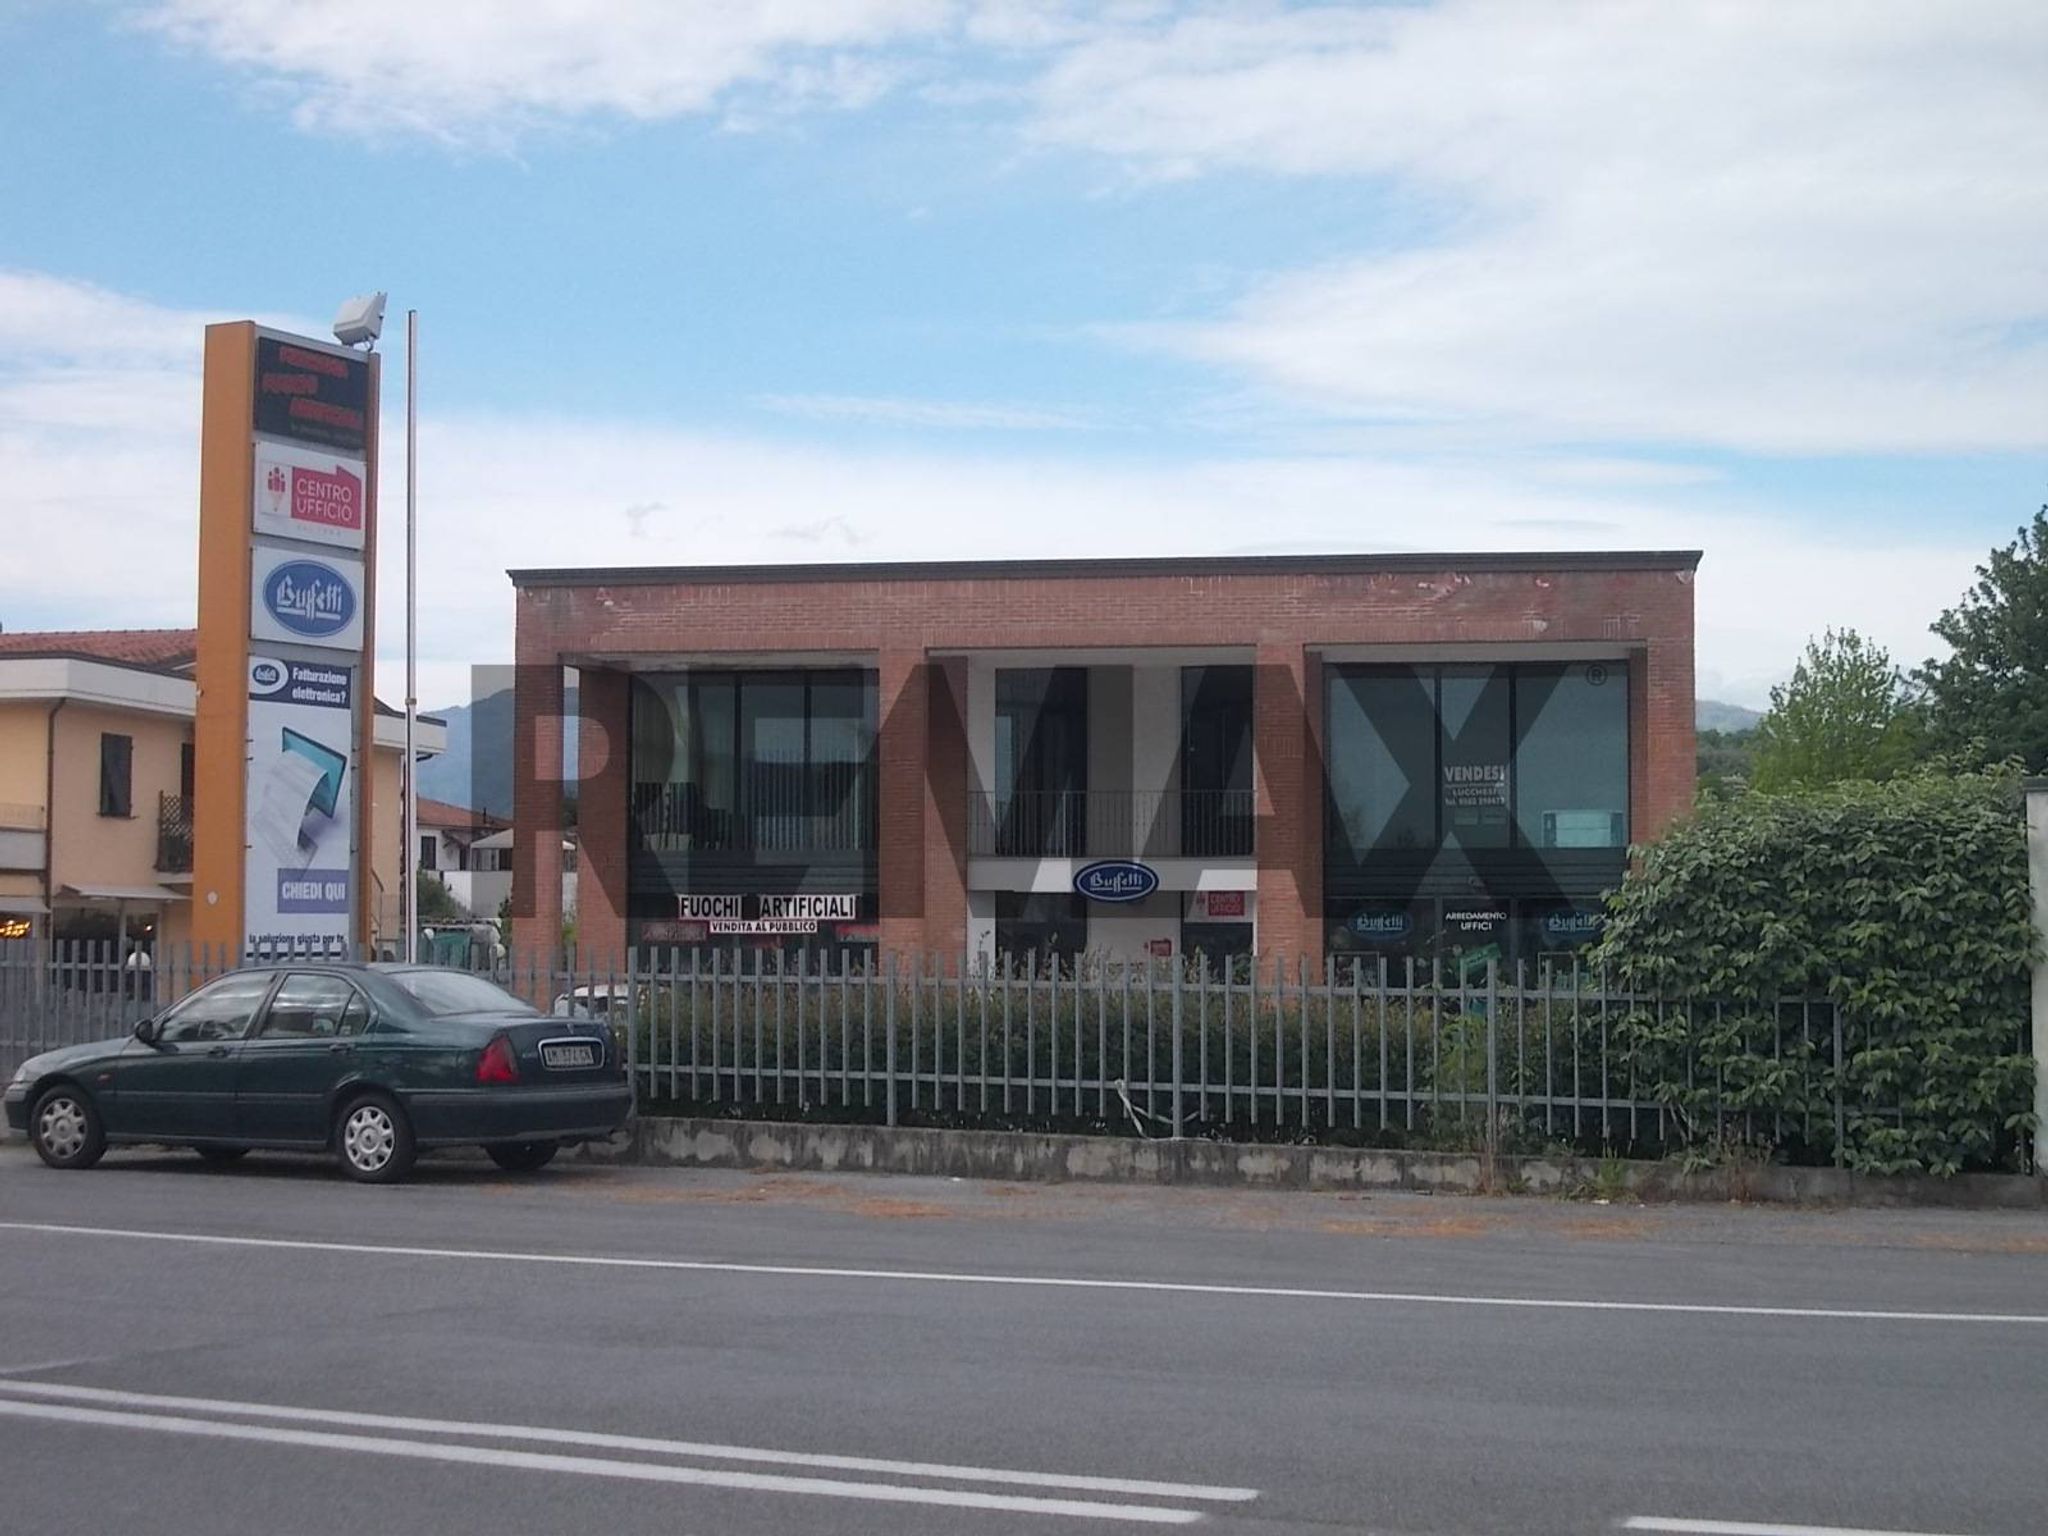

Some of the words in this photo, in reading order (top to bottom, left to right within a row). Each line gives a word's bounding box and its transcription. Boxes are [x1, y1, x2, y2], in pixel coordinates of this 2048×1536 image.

[296, 478, 352, 503] CENTRO
[296, 497, 352, 521] UFFICIO
[292, 667, 347, 685] Fatturazione
[292, 686, 346, 704] elettronica?
[1444, 765, 1505, 782] VENDESI
[282, 881, 323, 900] CHIEDI
[325, 882, 346, 902] QUI
[680, 897, 739, 918] FUOCHI
[760, 896, 854, 917] ARTIFICIALI
[1445, 911, 1507, 920] ARREDAMENTO
[712, 921, 752, 932] VENDITA
[755, 921, 767, 931] AL
[769, 921, 816, 932] PUBBLICO
[1460, 922, 1492, 931] UFFICI
